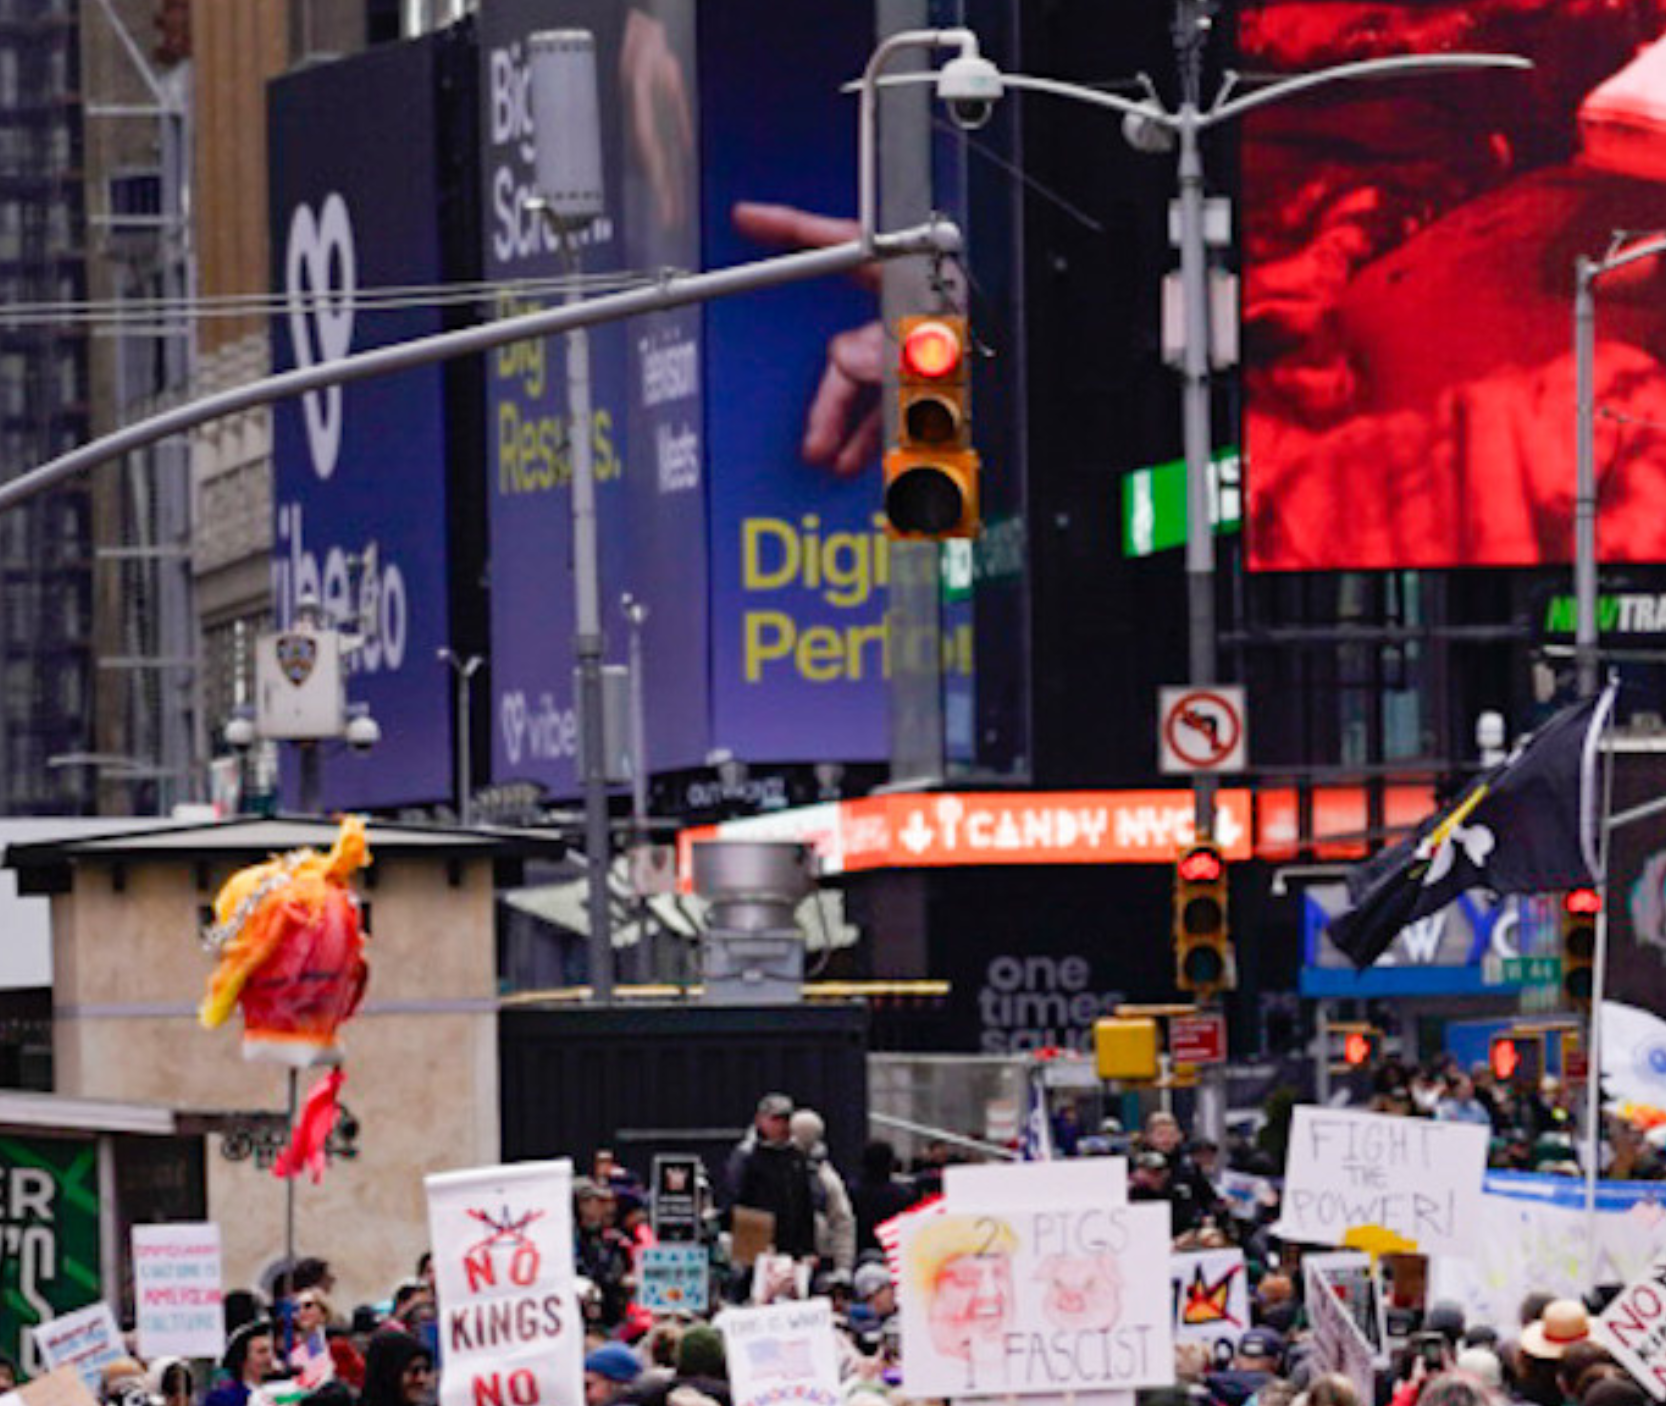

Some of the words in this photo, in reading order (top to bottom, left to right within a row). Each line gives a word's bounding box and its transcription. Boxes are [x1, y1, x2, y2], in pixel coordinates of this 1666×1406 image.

[499, 402, 621, 494] Resus.
[967, 808, 1108, 848] CANDY
[988, 955, 1090, 990] one
[1309, 1119, 1446, 1169] FIGHT
[974, 1215, 1000, 1260] 2
[1031, 1208, 1131, 1257] PIGS
[462, 1242, 541, 1296] NO
[449, 1295, 563, 1353] KINGS
[1606, 1283, 1663, 1349] NO
[1001, 1324, 1153, 1385] FASCIST
